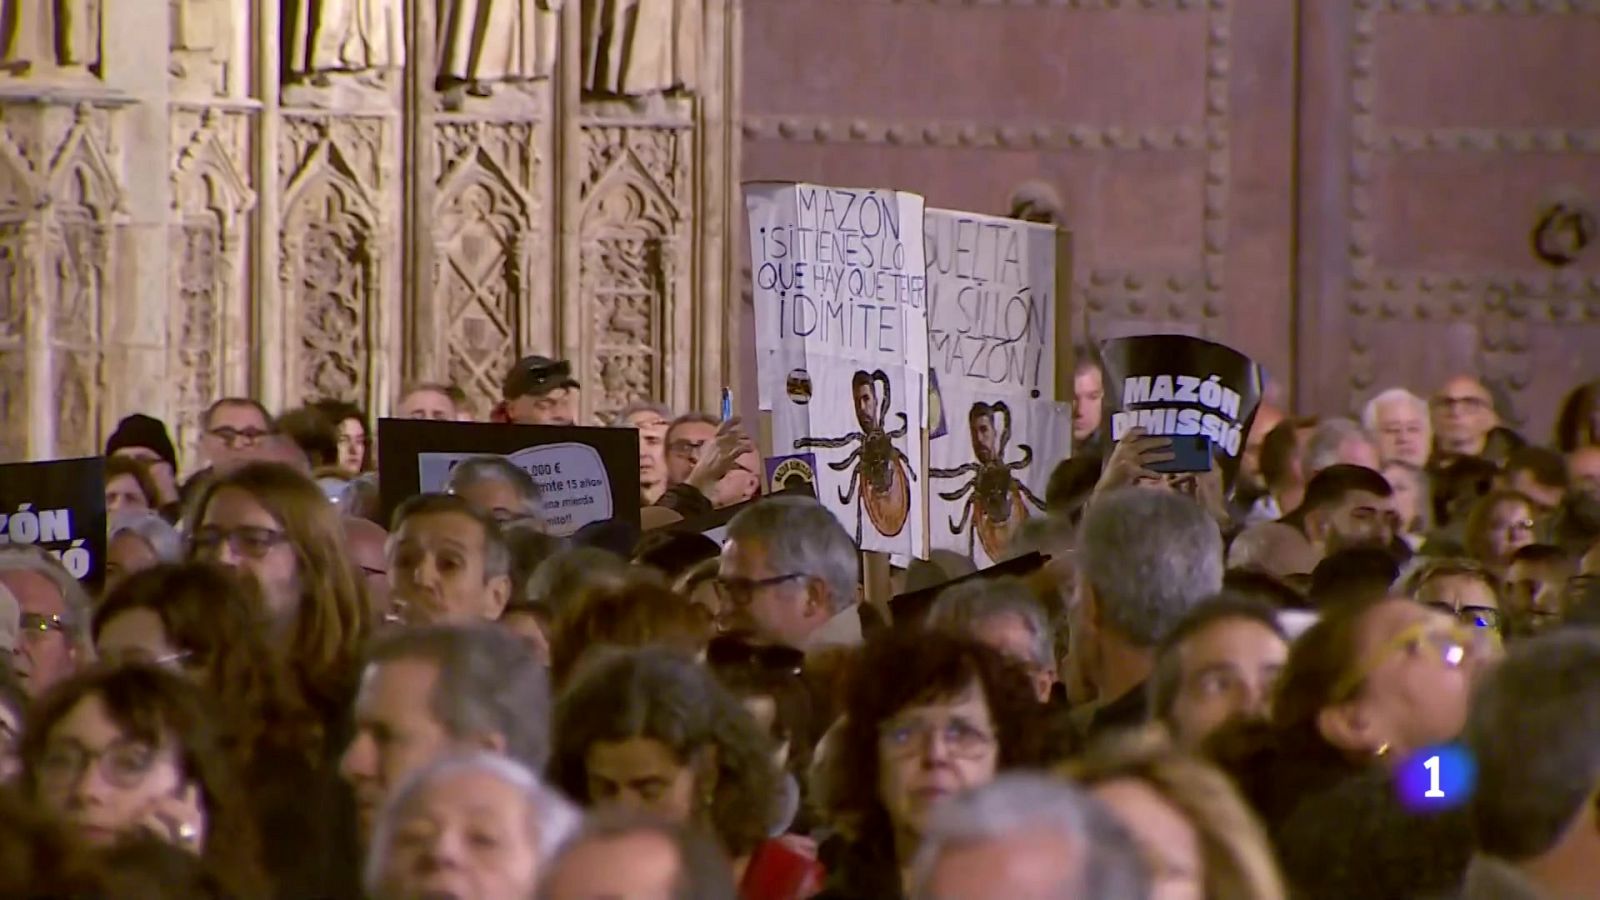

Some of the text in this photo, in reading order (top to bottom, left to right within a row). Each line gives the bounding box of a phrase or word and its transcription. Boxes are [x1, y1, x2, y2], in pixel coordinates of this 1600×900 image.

[800, 189, 899, 240] MAZÓN
[880, 239, 905, 270] LO
[758, 262, 808, 293] QUE
[813, 264, 845, 301] HAY
[849, 268, 885, 301] QUE
[1122, 374, 1241, 419] MAZÓN
[554, 462, 561, 474] €
